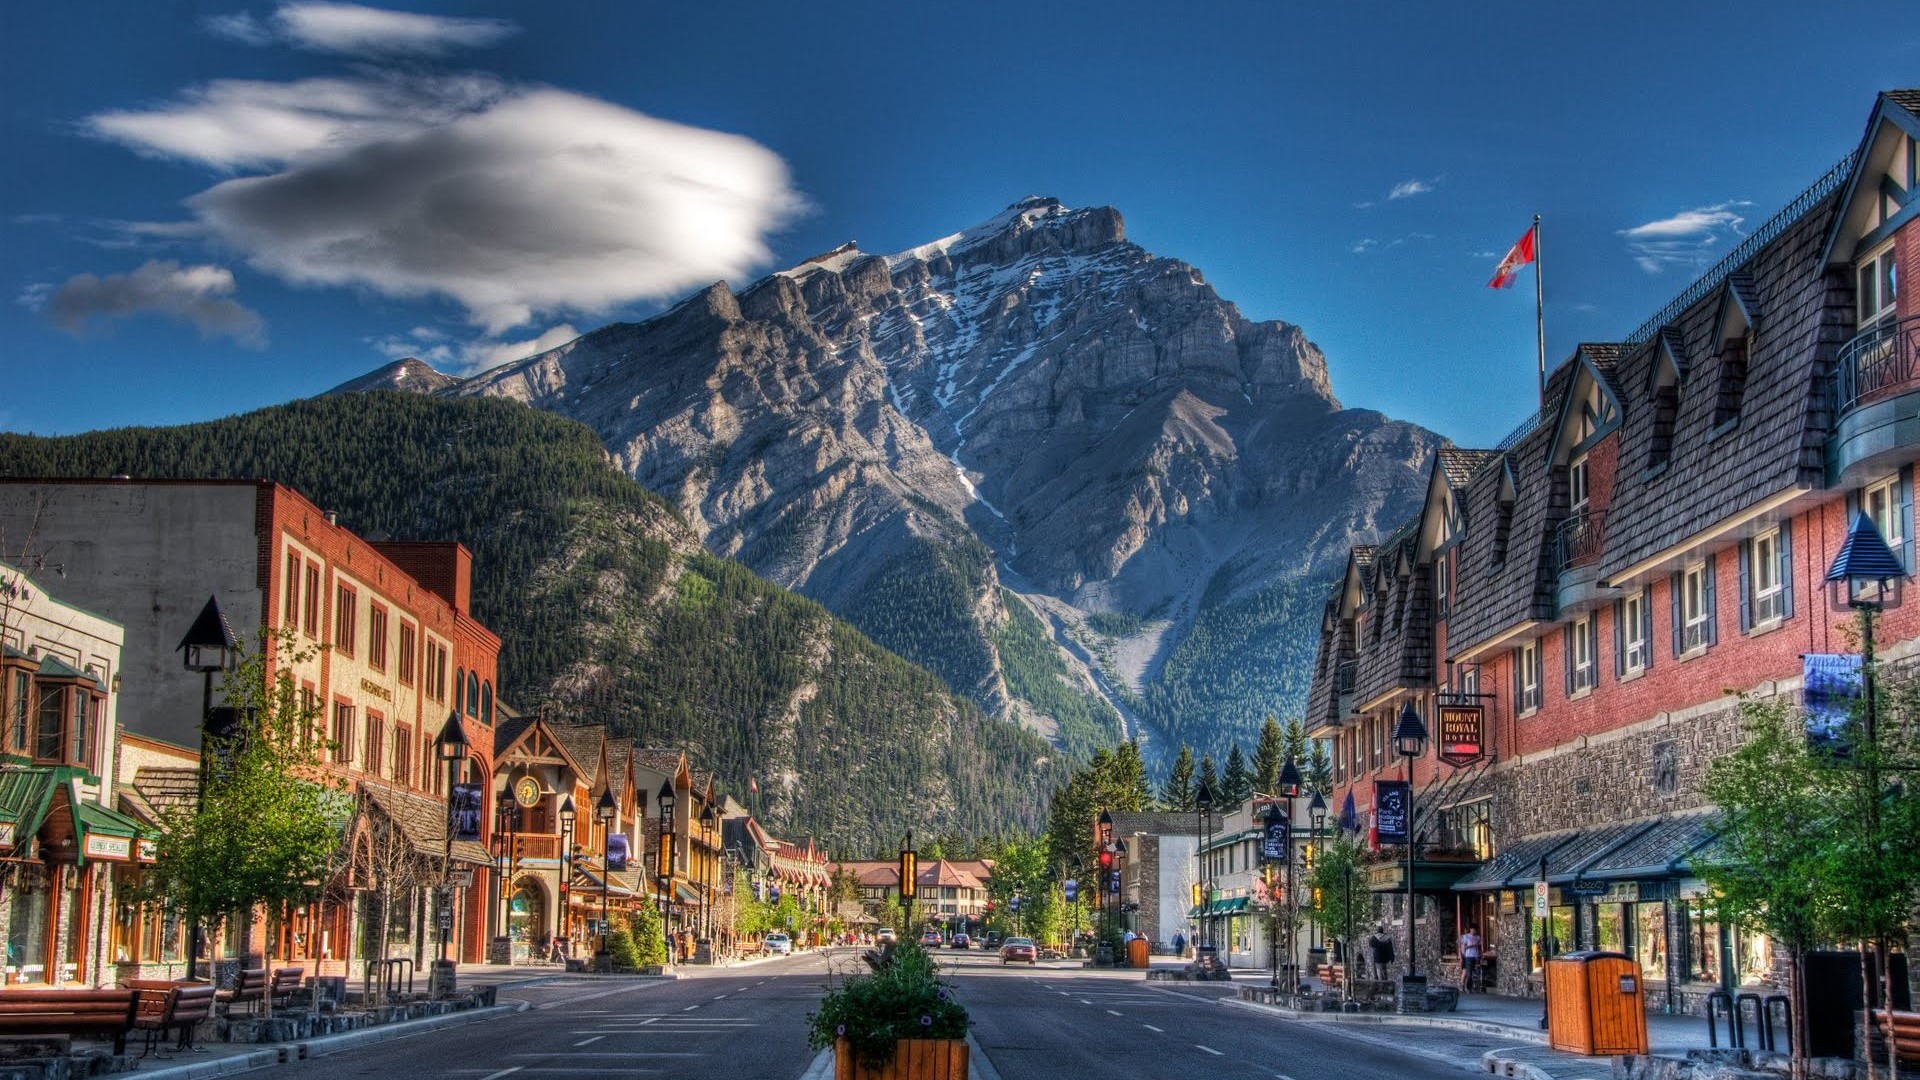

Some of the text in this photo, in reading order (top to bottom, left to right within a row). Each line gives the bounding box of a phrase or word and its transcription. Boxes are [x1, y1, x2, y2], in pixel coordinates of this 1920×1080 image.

[1444, 712, 1478, 722] MOUNT
[1445, 723, 1477, 733] ROYAL
[1378, 813, 1404, 821] National
